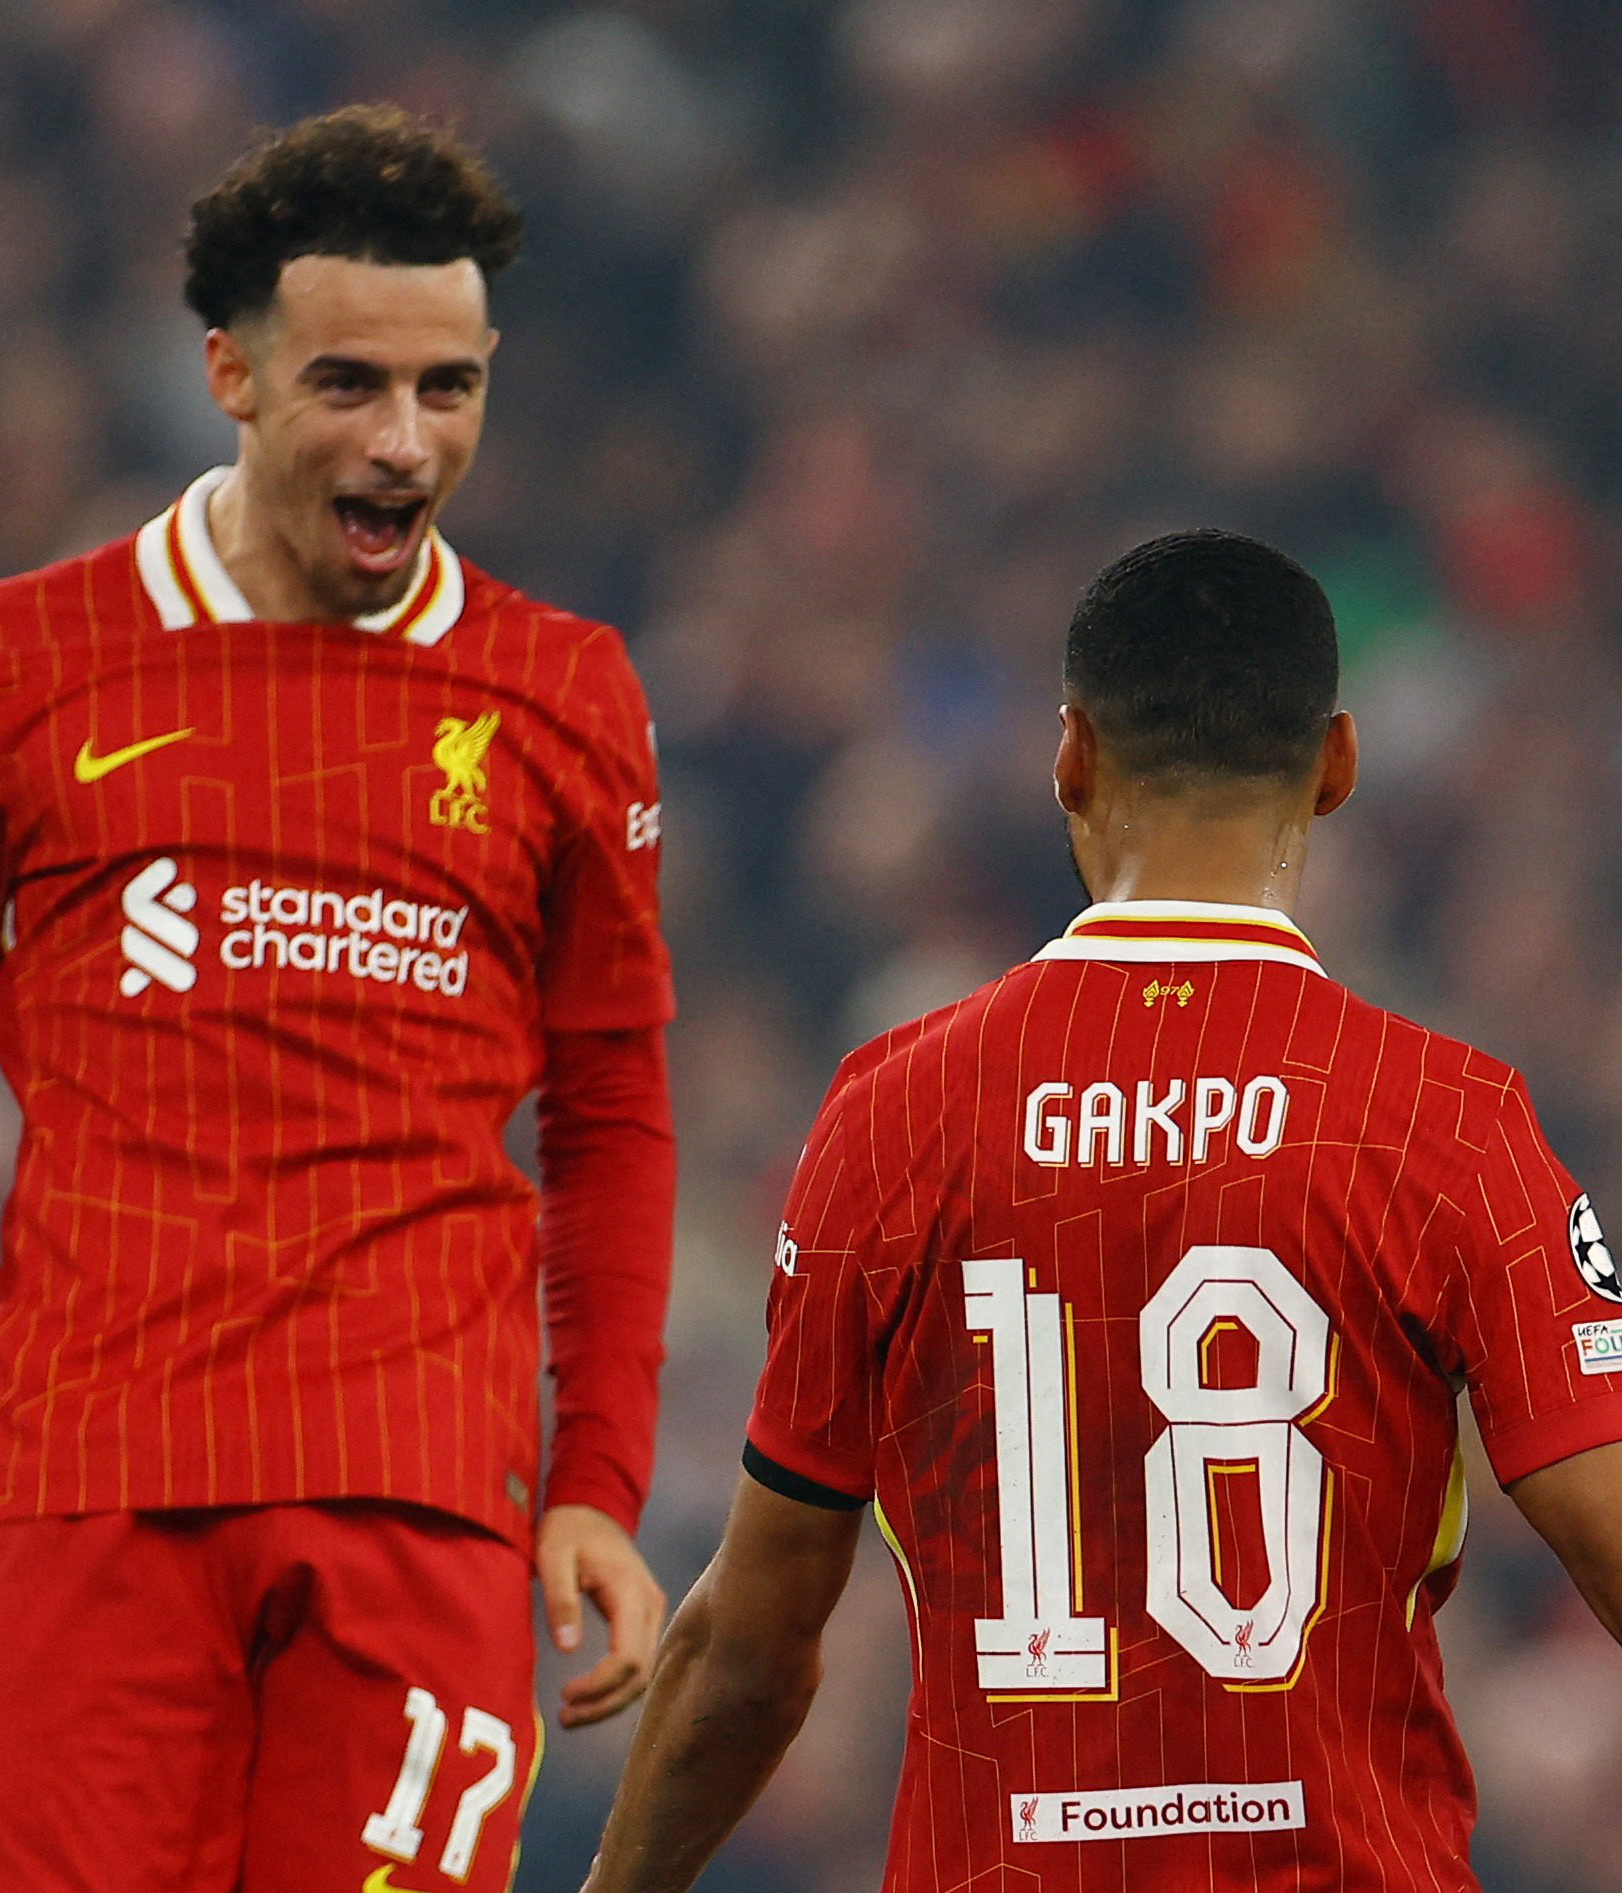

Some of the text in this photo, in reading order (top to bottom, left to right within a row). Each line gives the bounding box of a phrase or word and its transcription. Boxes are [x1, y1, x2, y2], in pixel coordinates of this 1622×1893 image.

[429, 789, 492, 835] LFC
[221, 879, 469, 949] standard
[220, 924, 468, 997] chartered
[1160, 985, 1179, 996] 97
[1024, 1075, 1290, 1168] GAKPO
[1577, 1325, 1609, 1337] UEFA
[961, 1245, 1338, 1700] 18
[361, 1686, 518, 1882] 17
[1061, 1791, 1291, 1832] Foundation
